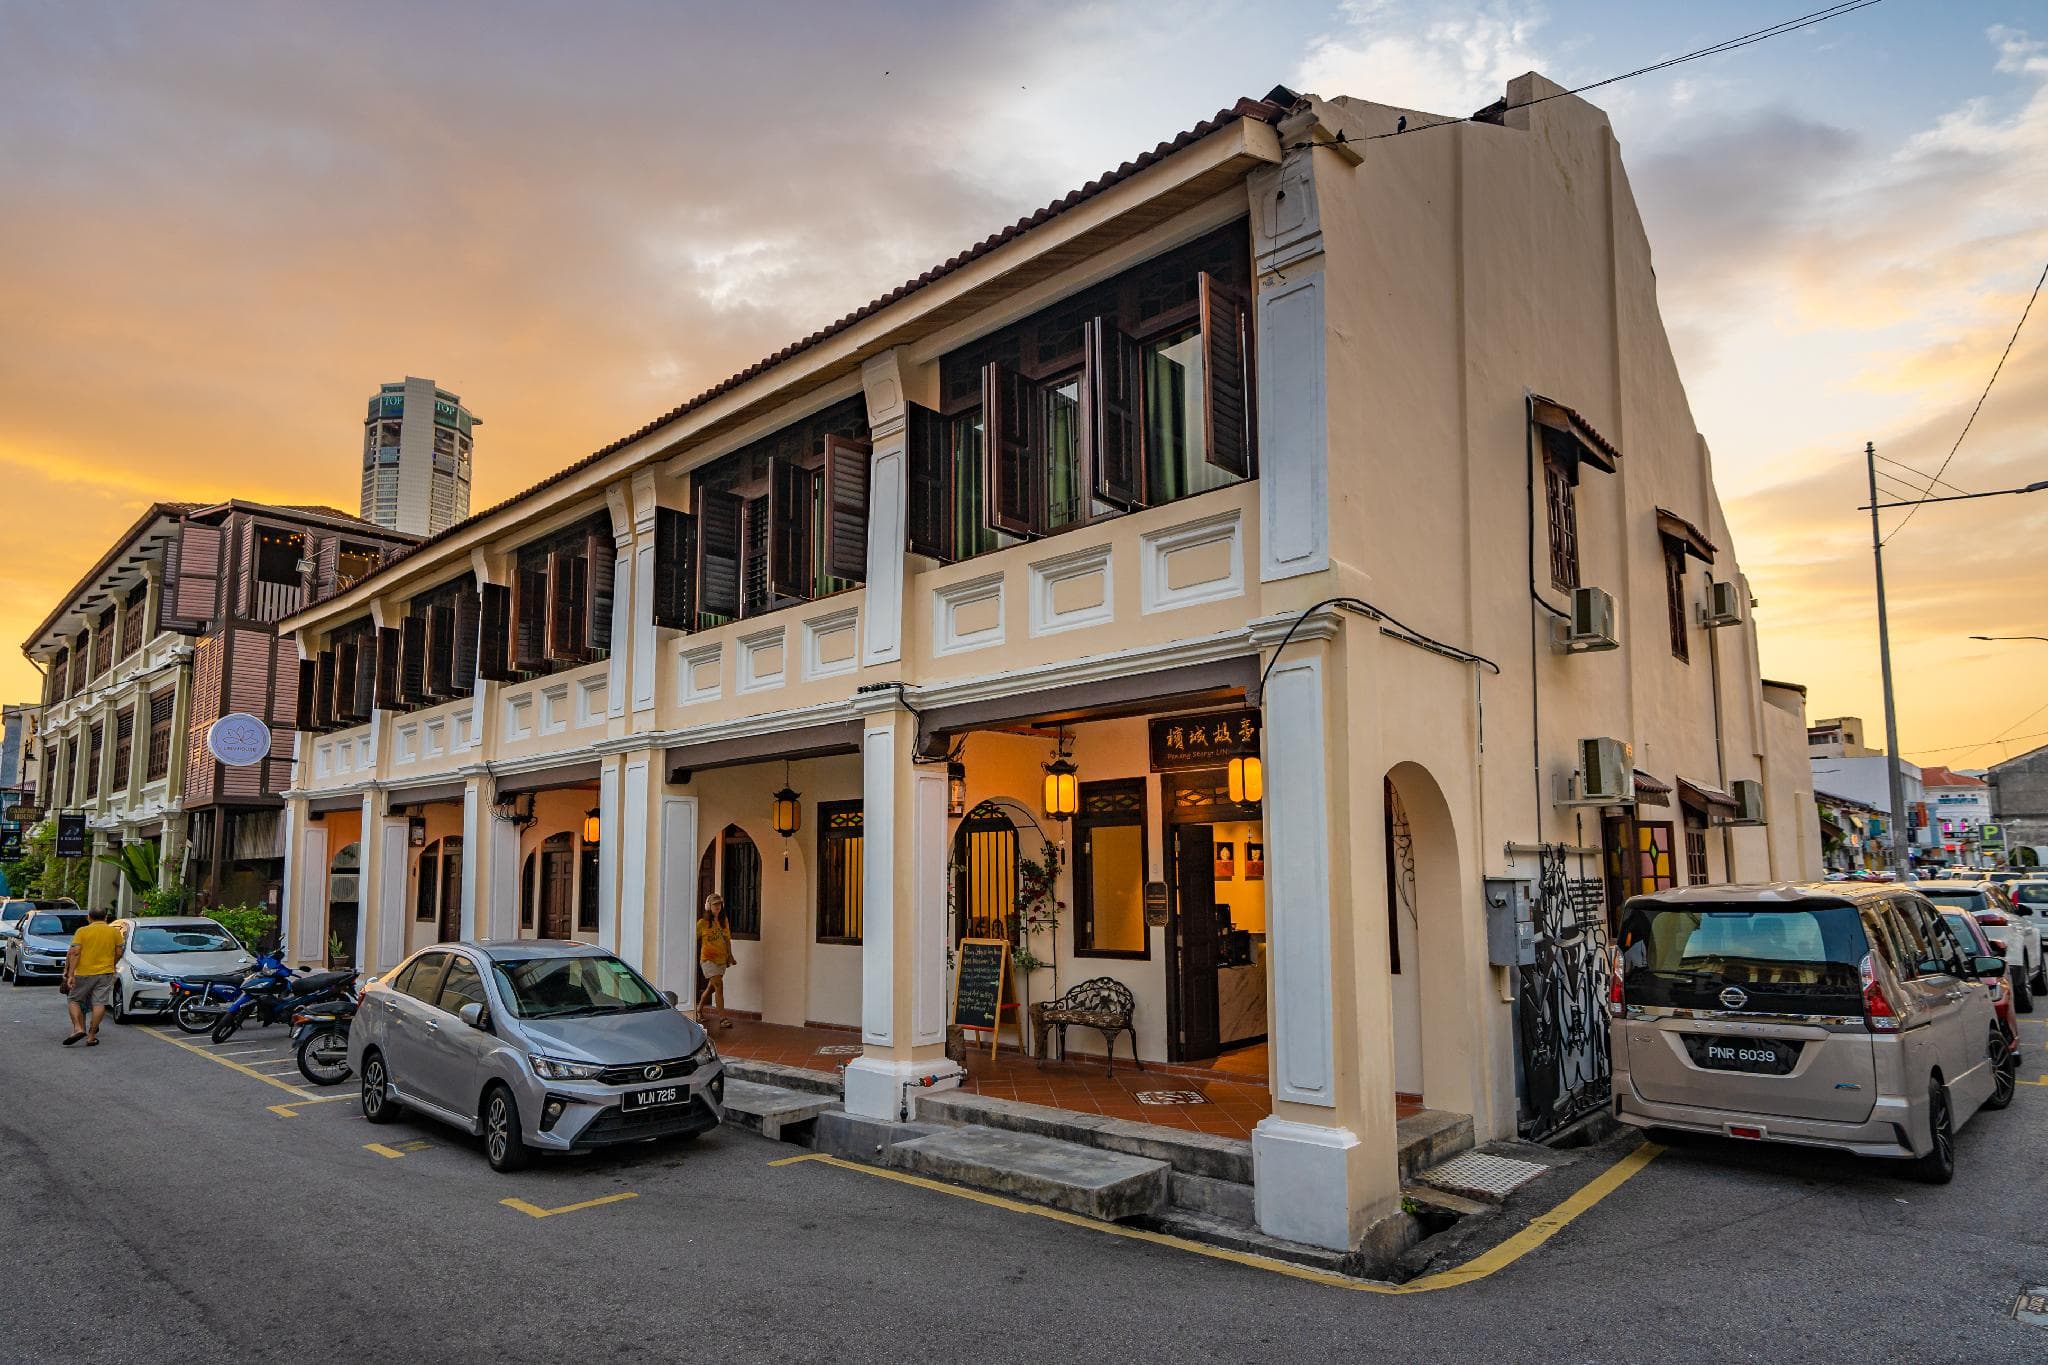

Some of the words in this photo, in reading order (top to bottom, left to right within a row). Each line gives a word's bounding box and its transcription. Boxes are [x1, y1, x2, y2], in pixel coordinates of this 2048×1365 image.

[384, 397, 402, 406] TOP
[436, 401, 455, 415] TOP
[1983, 825, 1999, 840] P
[1708, 1046, 1735, 1059] PNR
[1739, 1049, 1776, 1062] 6039
[637, 1091, 655, 1105] VLN
[656, 1088, 676, 1102] 7215
